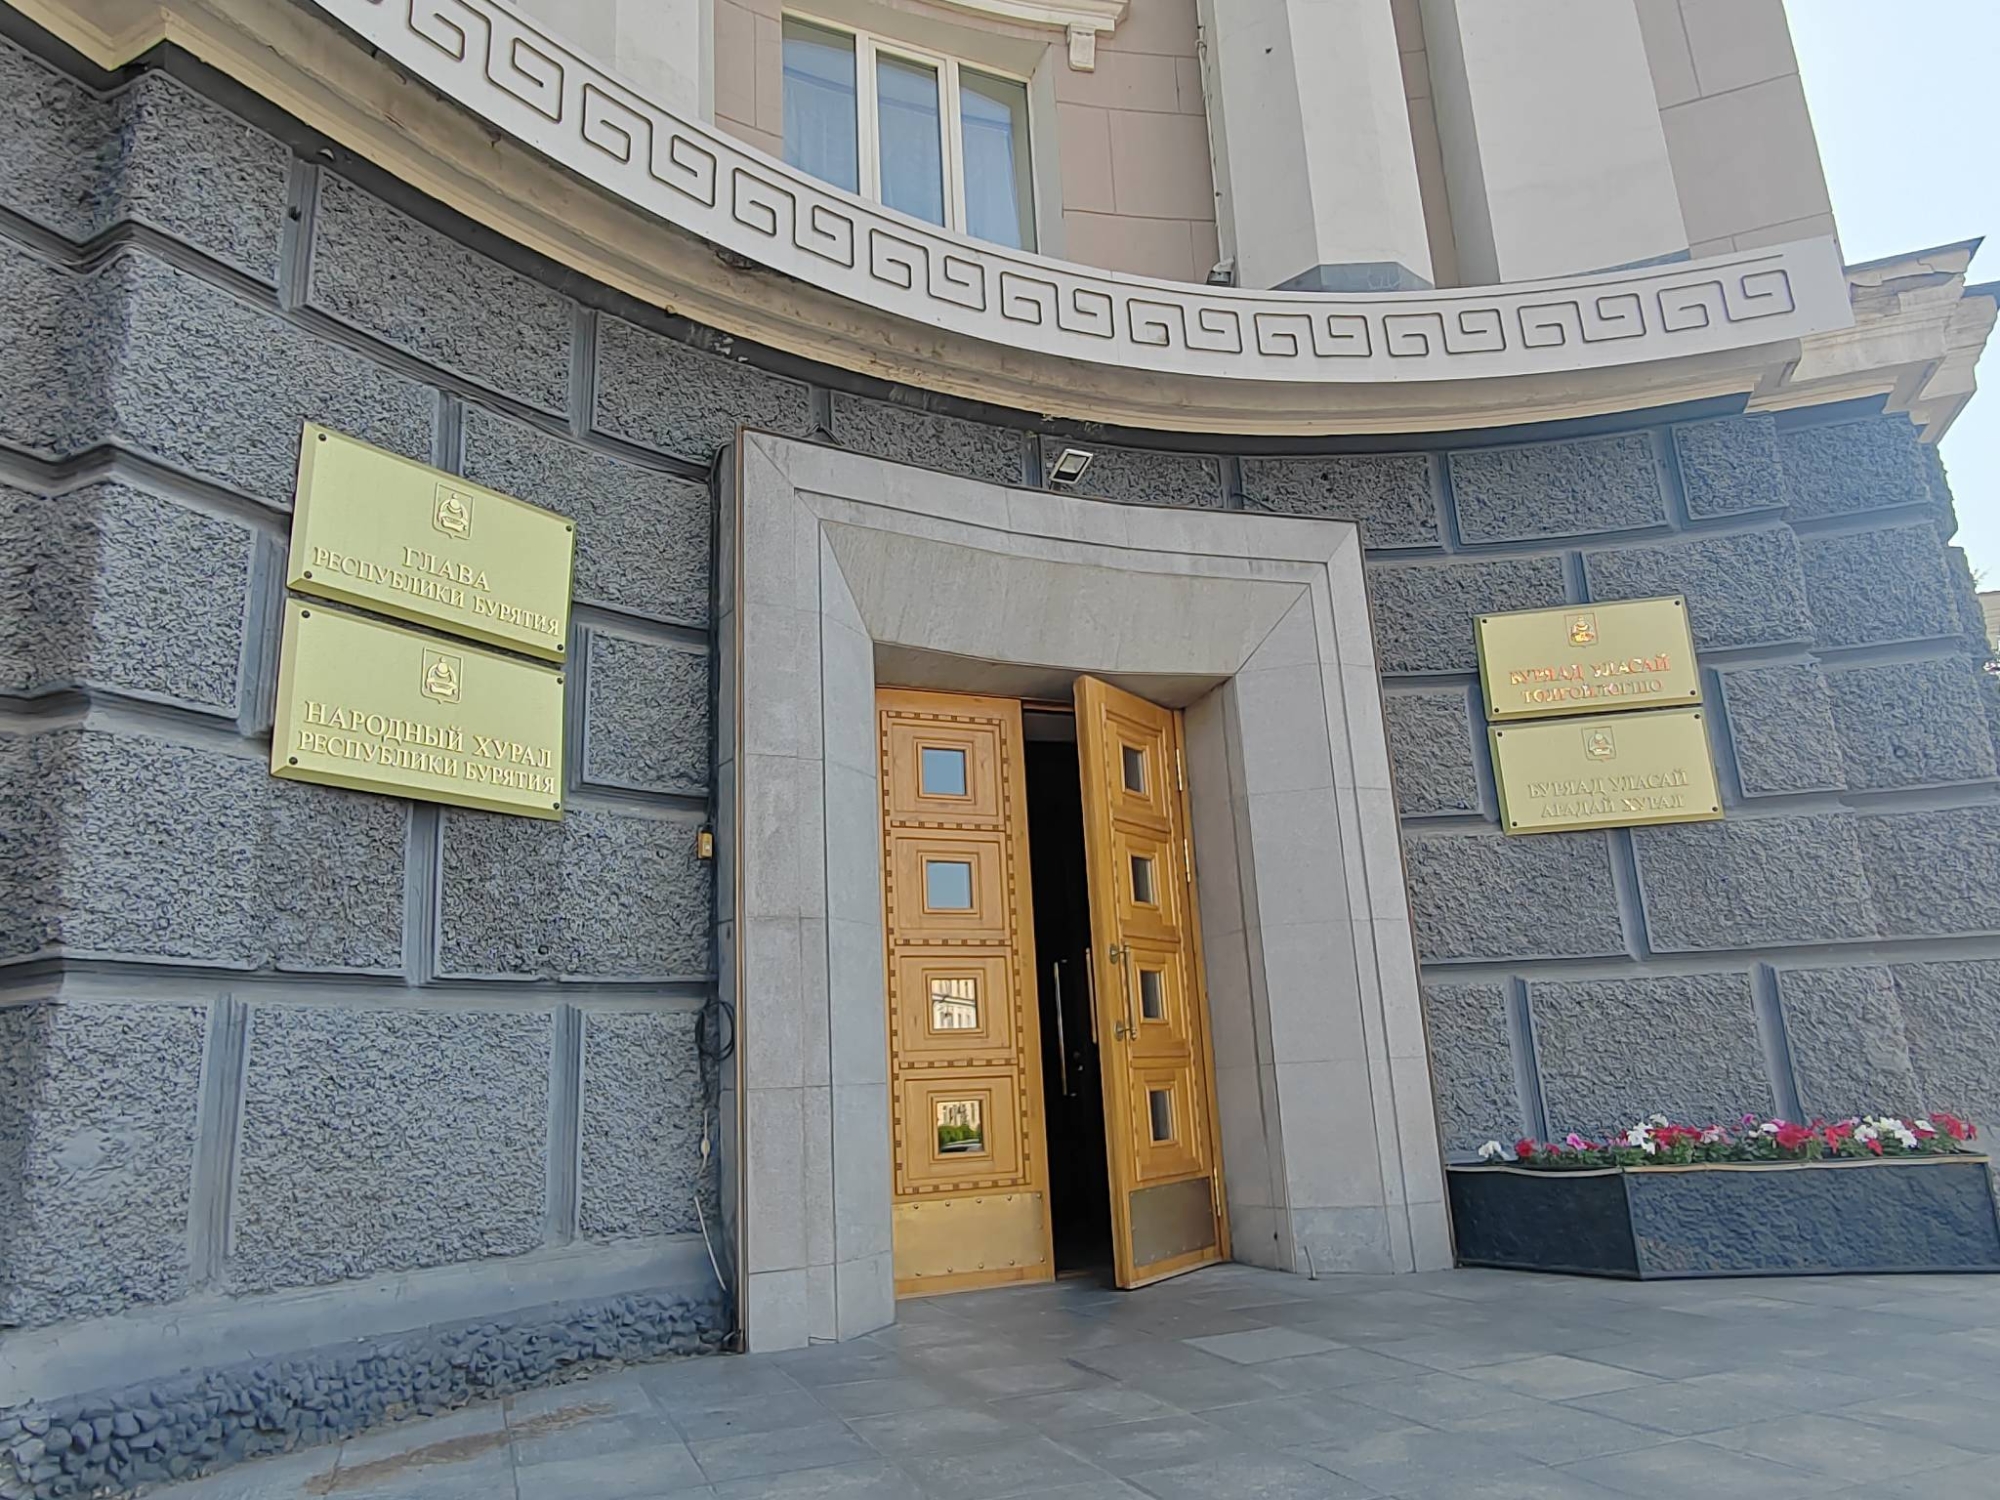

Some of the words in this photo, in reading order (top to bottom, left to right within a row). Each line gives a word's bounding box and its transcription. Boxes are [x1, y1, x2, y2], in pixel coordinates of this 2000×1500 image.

[313, 546, 465, 609] РЕСПУБЛИКИ
[473, 595, 560, 636] БУРЯТИЯ
[402, 546, 491, 592] ГЛАВА
[304, 700, 464, 753] НАРОДНЫЙ
[472, 735, 552, 769] ХУРАЛ
[299, 731, 457, 778] РЕСПУБЛИКИ
[464, 761, 555, 794] БУРЯТИЯ
[1529, 778, 1606, 798] БУРЯАД
[1608, 769, 1688, 792] УЛАСАЙ
[1541, 798, 1615, 818] АРАДАЙ
[1621, 795, 1684, 812] ХУРАЛ
